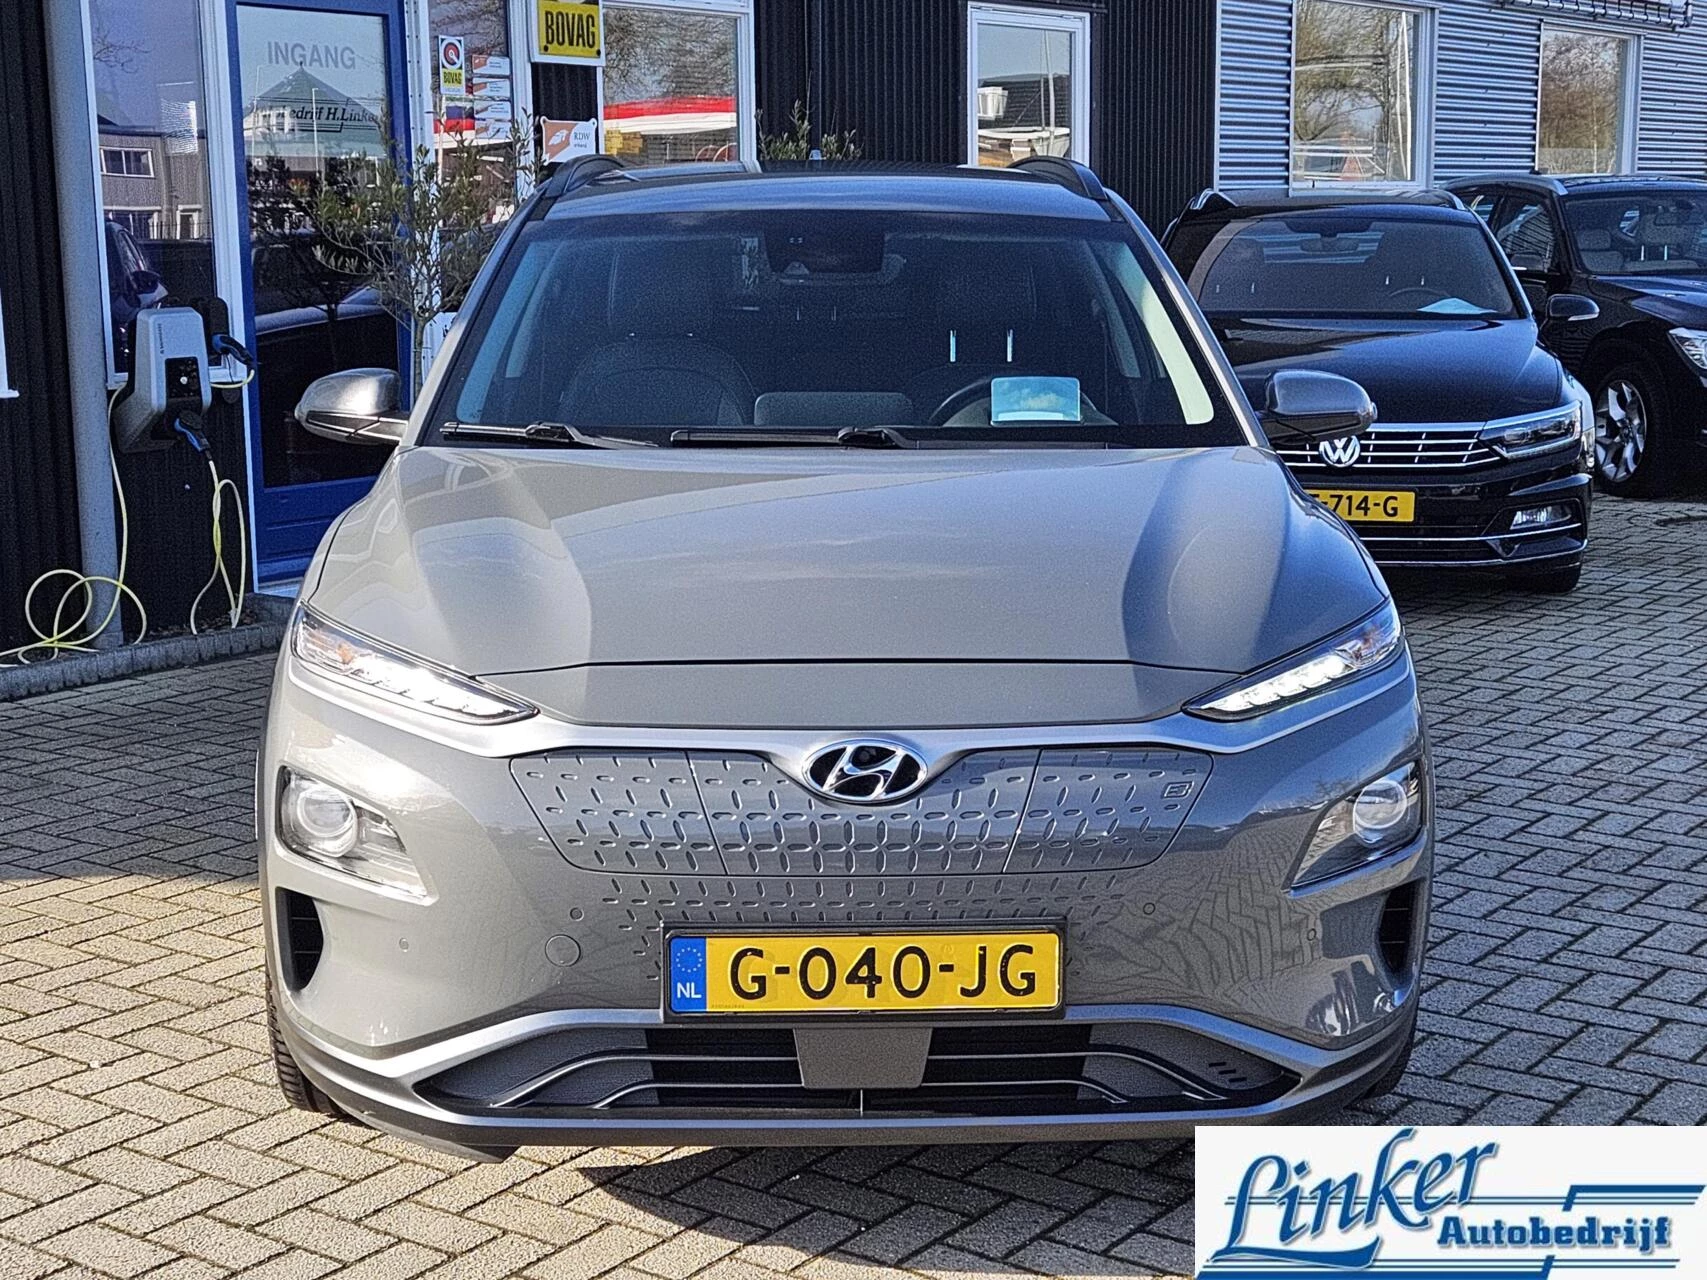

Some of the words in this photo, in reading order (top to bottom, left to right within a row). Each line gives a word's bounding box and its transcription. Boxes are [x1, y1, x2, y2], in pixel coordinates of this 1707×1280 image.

[545, 10, 596, 48] BOVAG
[267, 41, 356, 69] INGANG
[443, 71, 462, 84] BOVAG
[1309, 494, 1398, 517] -714-G
[729, 944, 1036, 1000] G-040-JG
[676, 983, 702, 998] NL
